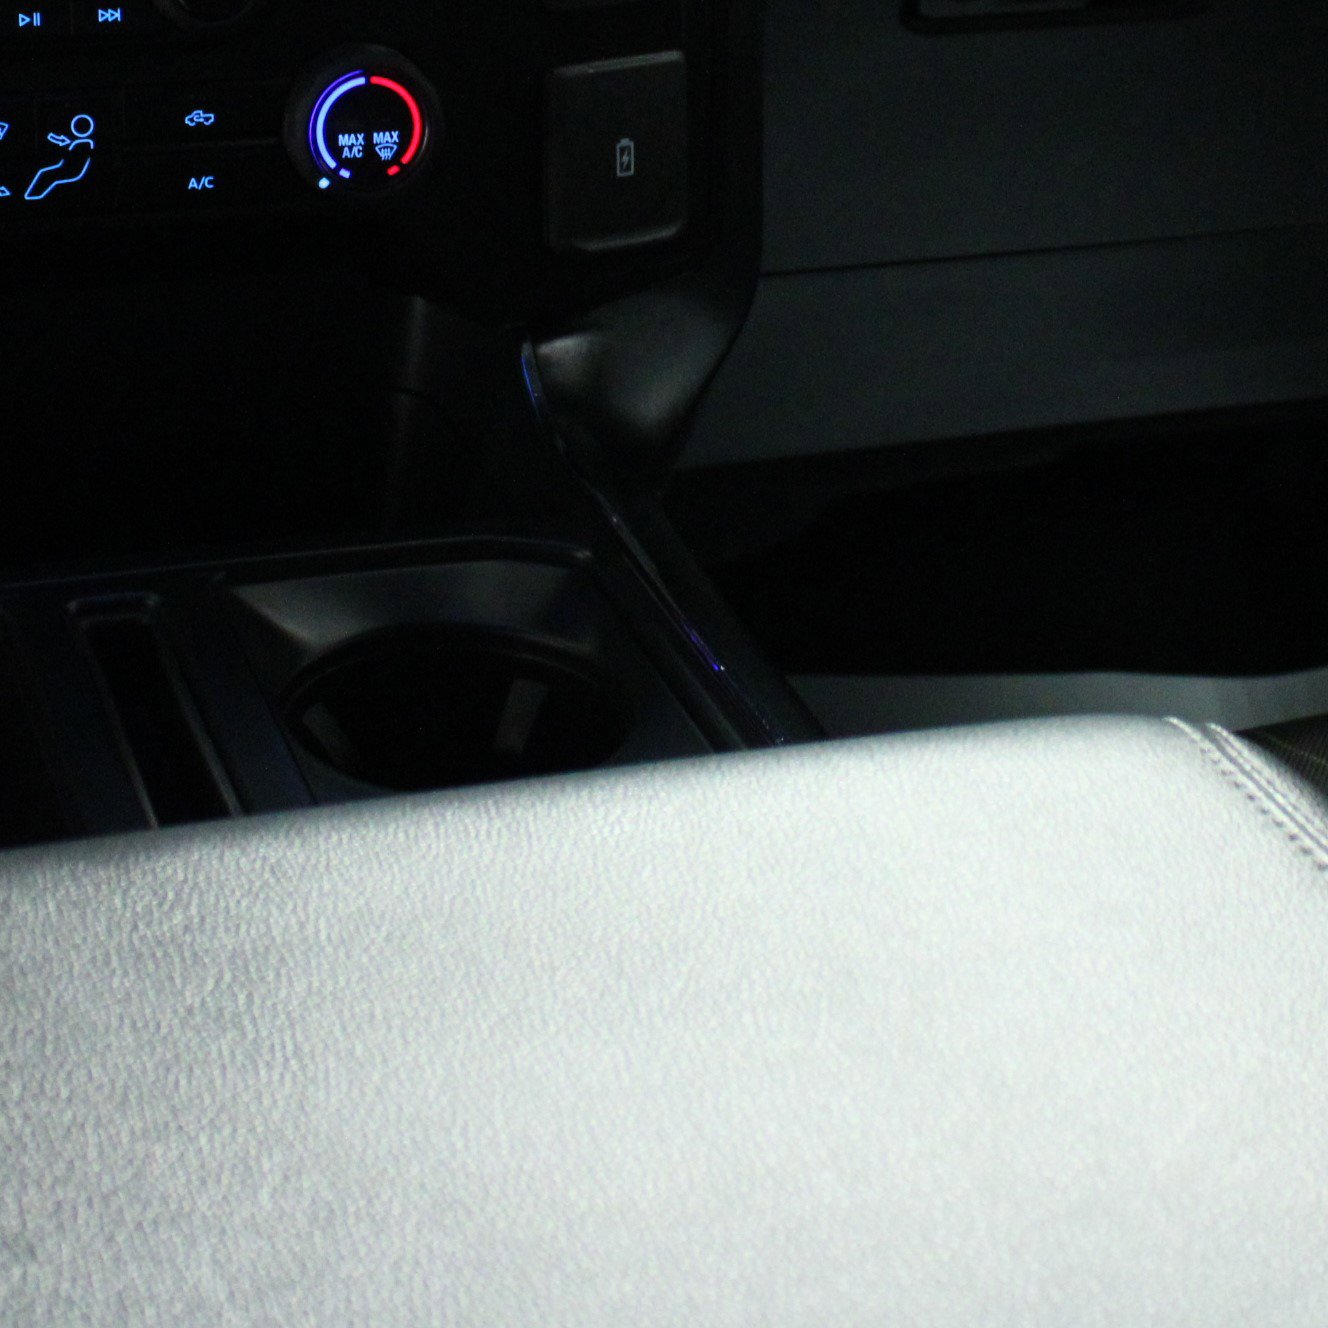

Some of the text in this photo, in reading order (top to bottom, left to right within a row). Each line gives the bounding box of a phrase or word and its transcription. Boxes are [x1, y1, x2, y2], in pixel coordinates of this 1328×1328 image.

[338, 133, 364, 147] MAX
[373, 131, 399, 144] MAX
[342, 146, 363, 159] A/C
[188, 176, 214, 191] A/C
